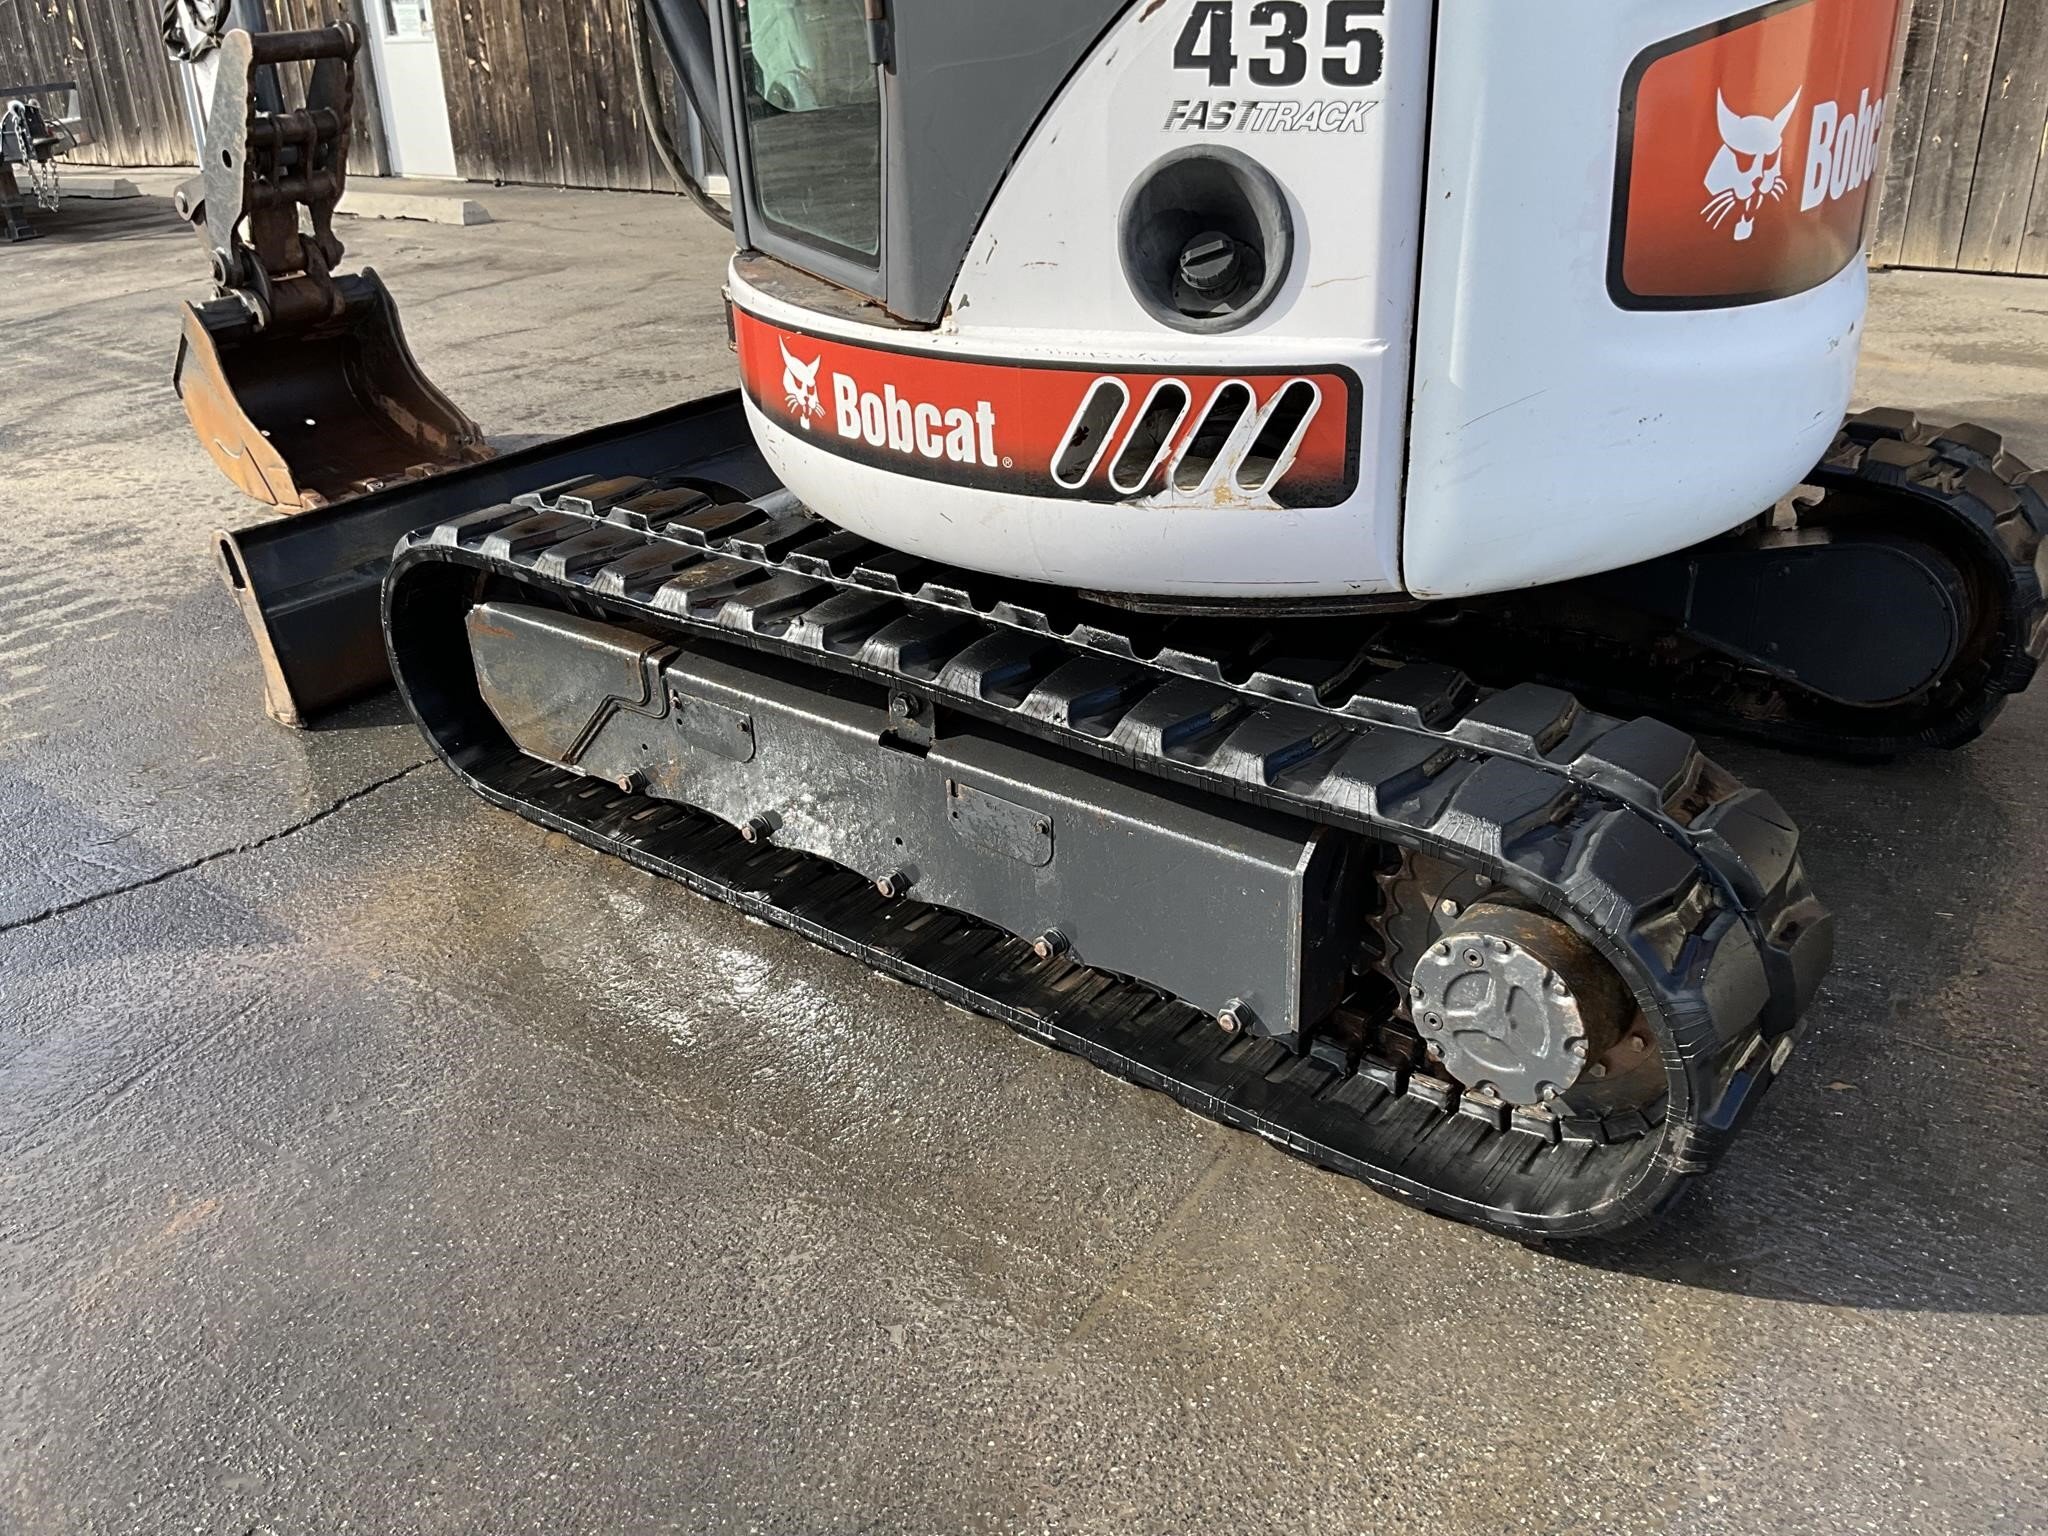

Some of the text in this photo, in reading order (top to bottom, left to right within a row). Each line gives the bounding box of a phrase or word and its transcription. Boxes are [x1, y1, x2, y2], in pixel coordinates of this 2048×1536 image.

[1173, 0, 1385, 87] 435
[1800, 87, 1887, 212] Bobc
[832, 372, 998, 468] Bobcat
